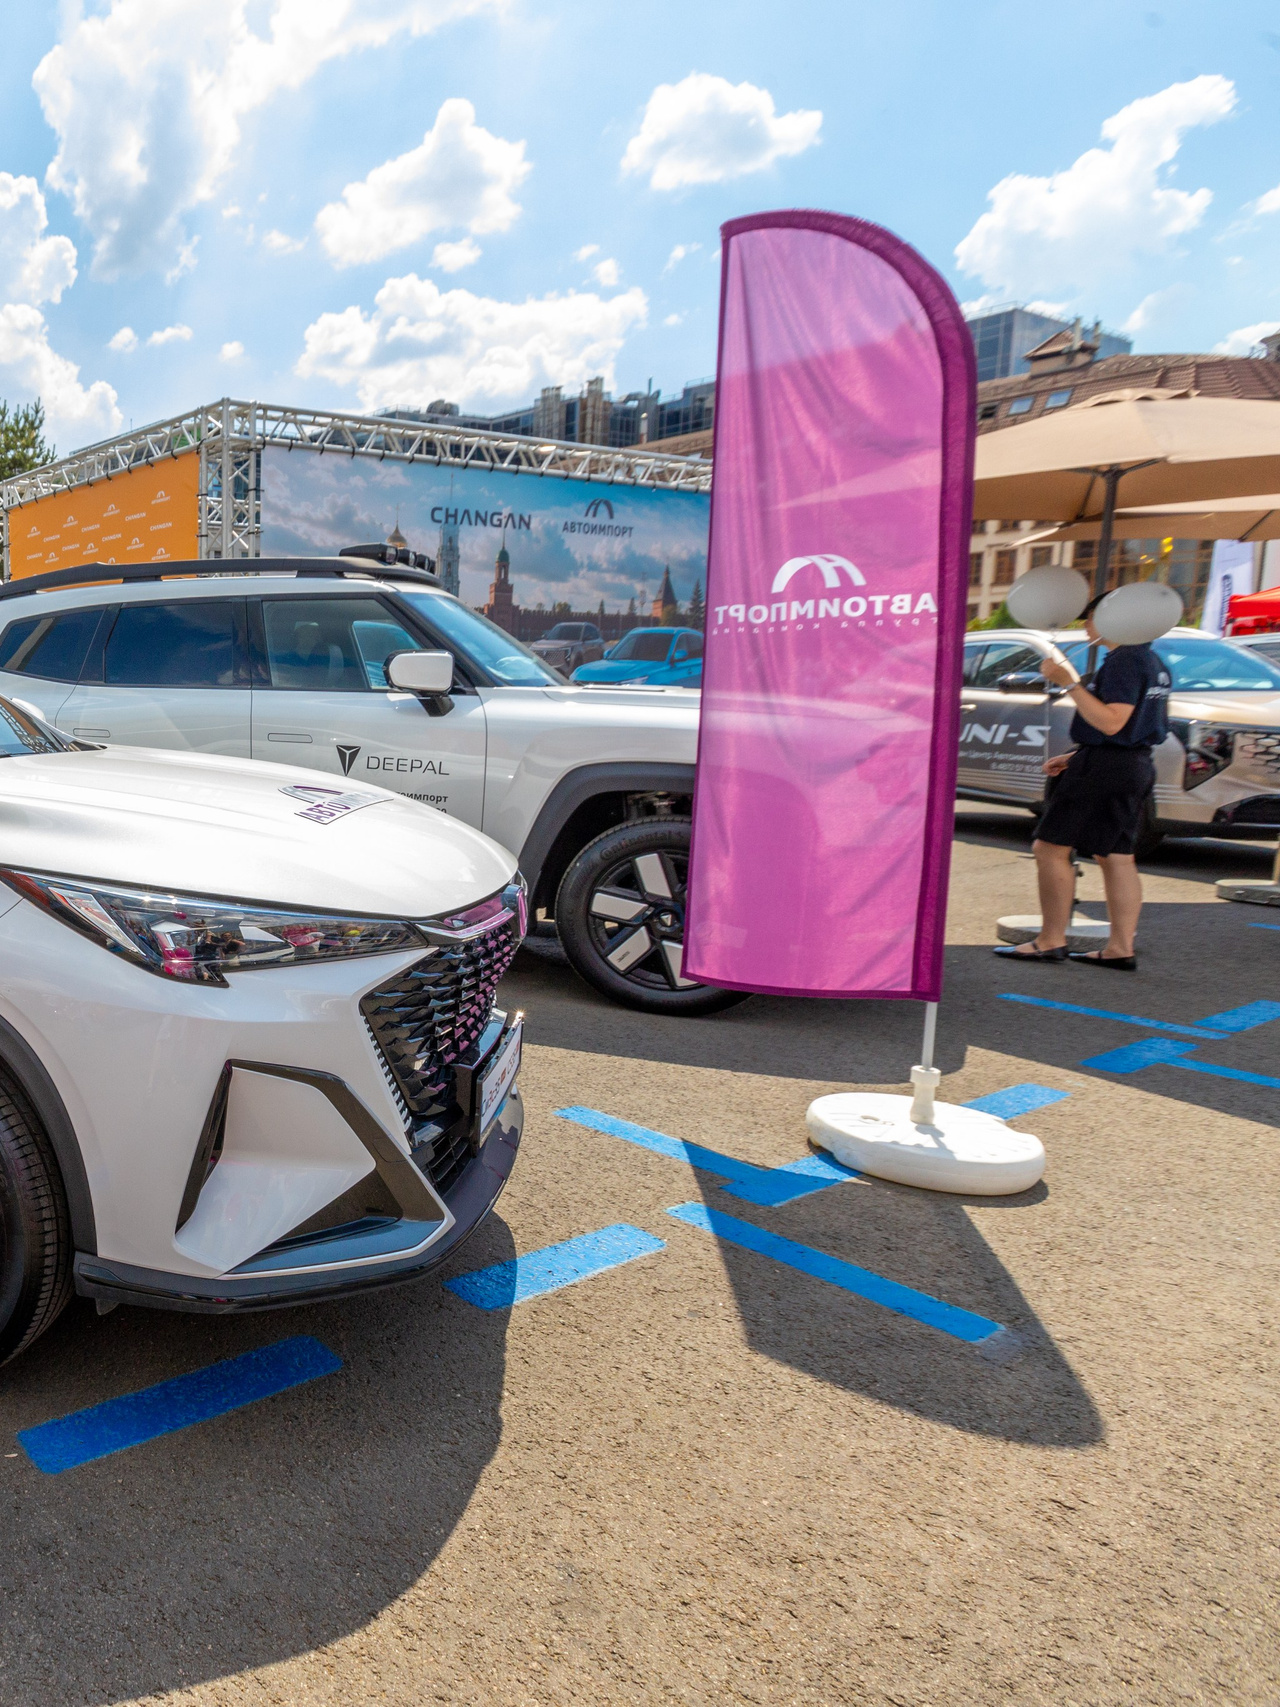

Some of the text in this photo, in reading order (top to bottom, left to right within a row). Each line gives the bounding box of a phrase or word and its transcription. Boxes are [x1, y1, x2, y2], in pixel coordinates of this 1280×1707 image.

[431, 506, 532, 531] CHANGAN
[562, 520, 634, 538] АВТОИМПОРТ
[366, 756, 450, 775] DEEPAL
